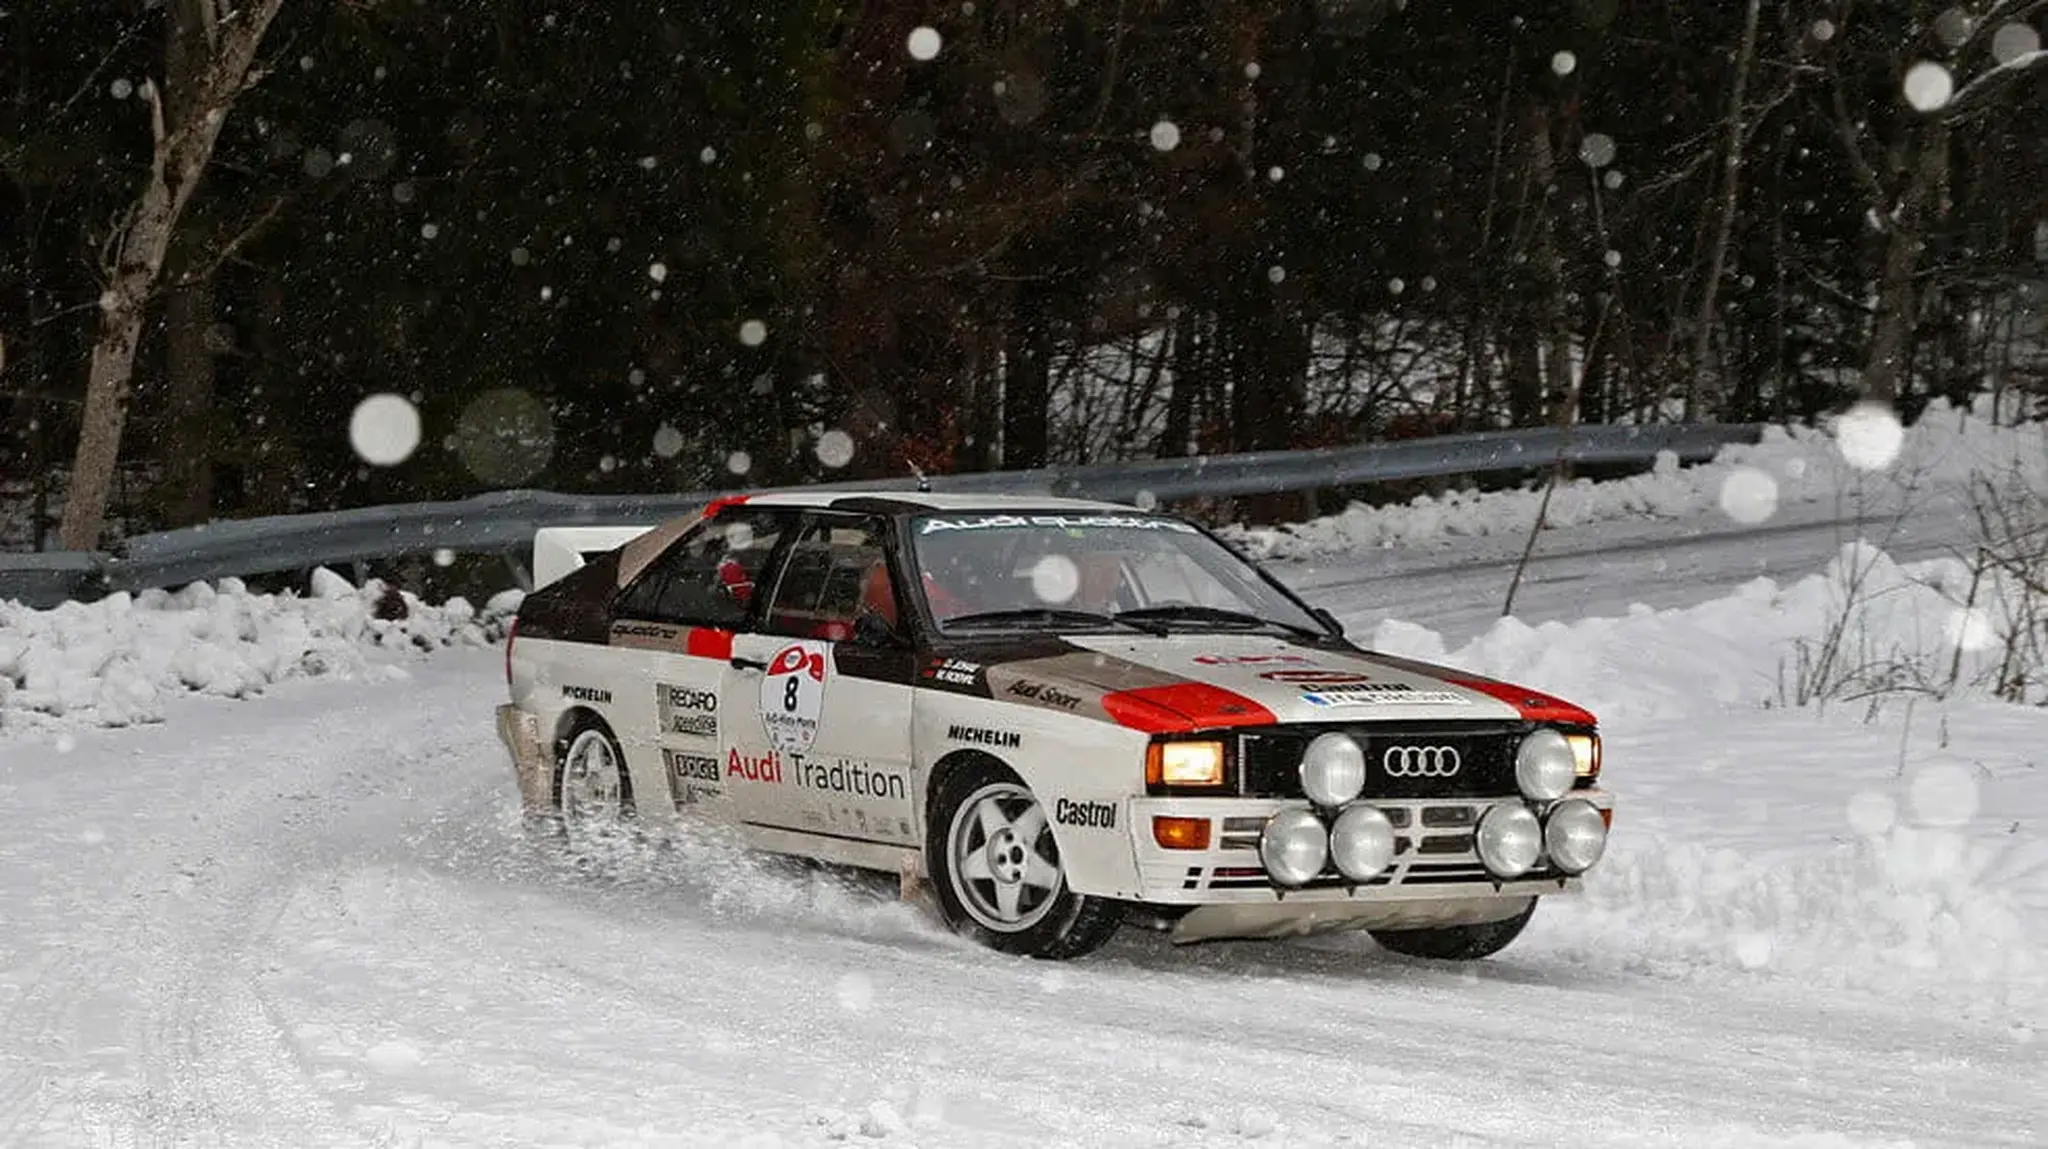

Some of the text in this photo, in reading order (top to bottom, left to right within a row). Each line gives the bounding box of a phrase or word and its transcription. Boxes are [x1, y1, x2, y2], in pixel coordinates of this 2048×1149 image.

[612, 624, 678, 638] quattro
[563, 685, 612, 704] MICHELIN
[670, 687, 717, 712] RECARO
[783, 675, 799, 711] 8
[1007, 680, 1082, 710] Audi Sport
[948, 725, 1020, 748] MICHELIN
[727, 748, 905, 799] Audi Tradition
[1056, 798, 1117, 829] Castrol
